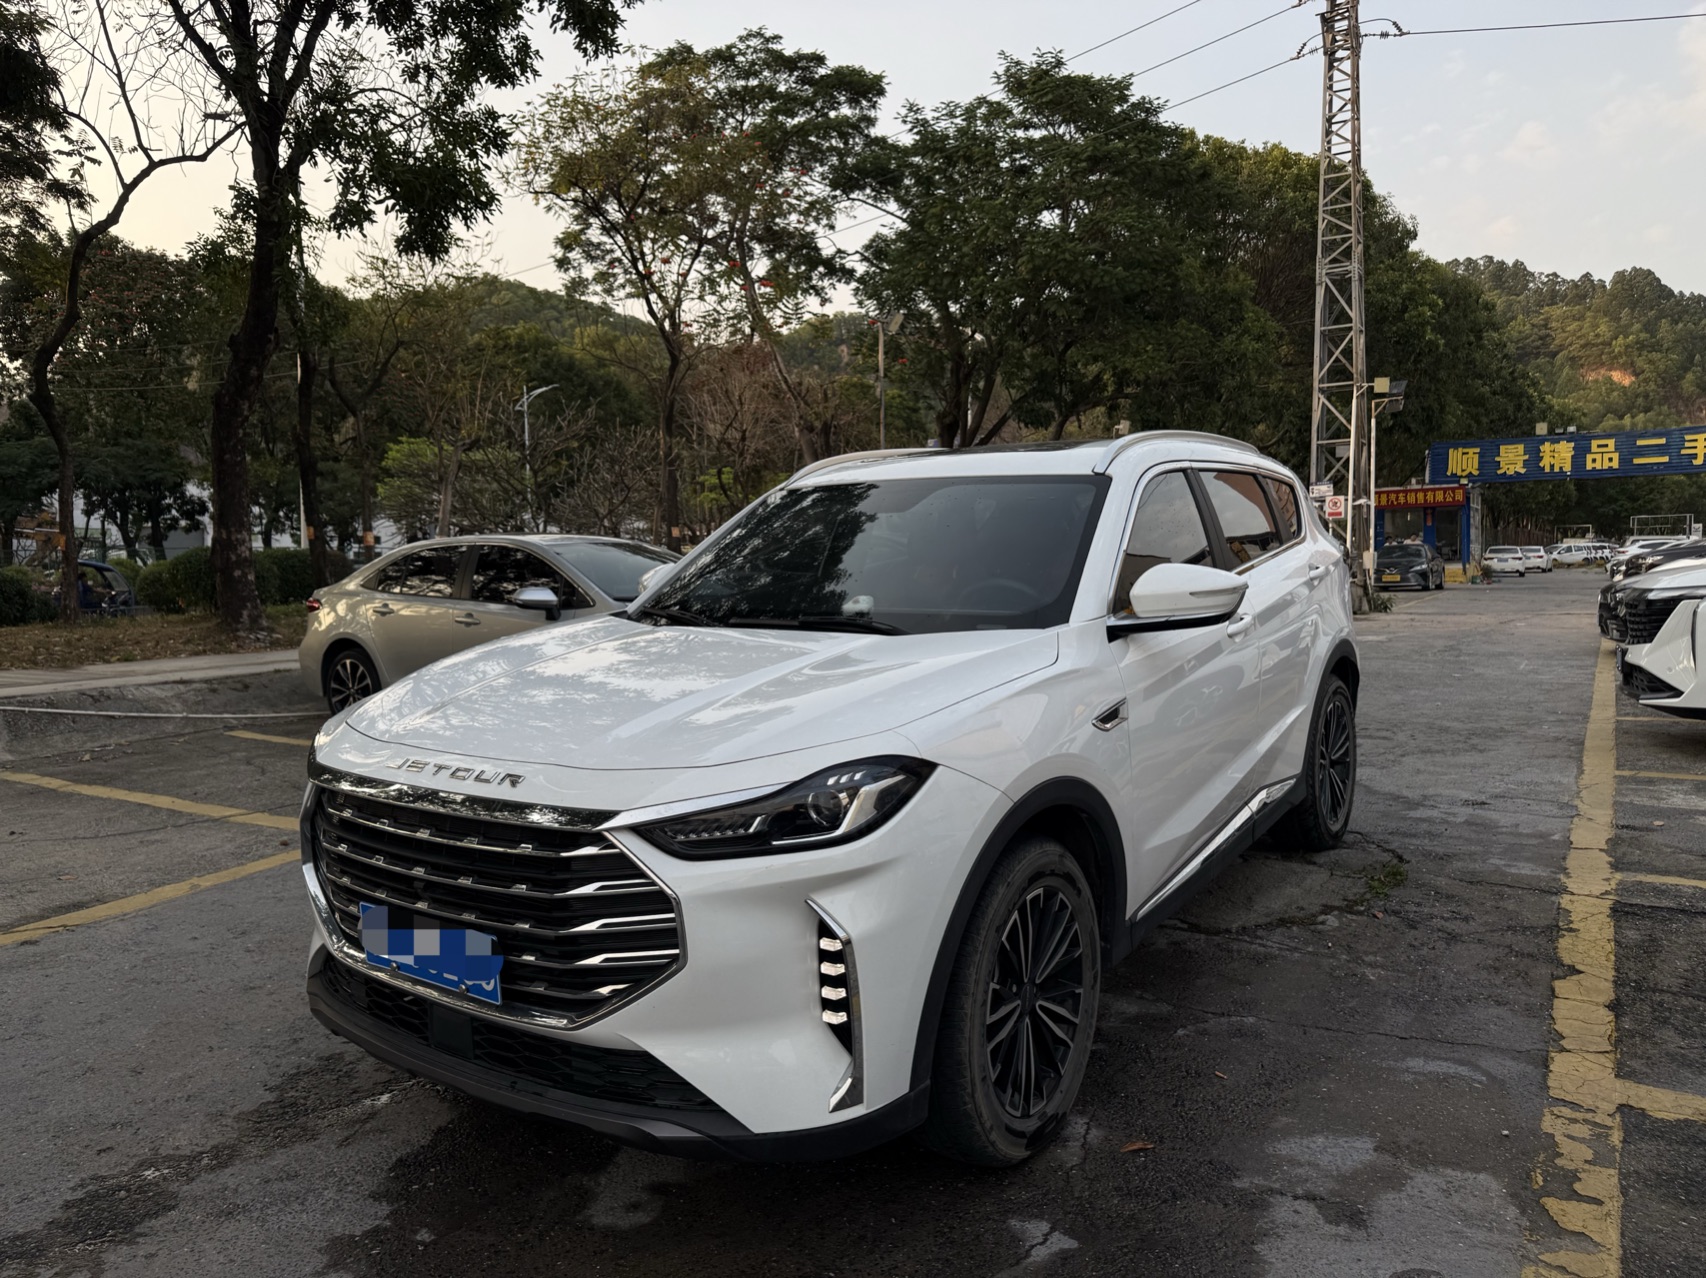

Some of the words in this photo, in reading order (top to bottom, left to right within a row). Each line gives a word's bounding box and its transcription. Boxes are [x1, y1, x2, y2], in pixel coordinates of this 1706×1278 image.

[1446, 432, 1706, 477] 顺景精品二手
[385, 757, 526, 788] JETOUR
